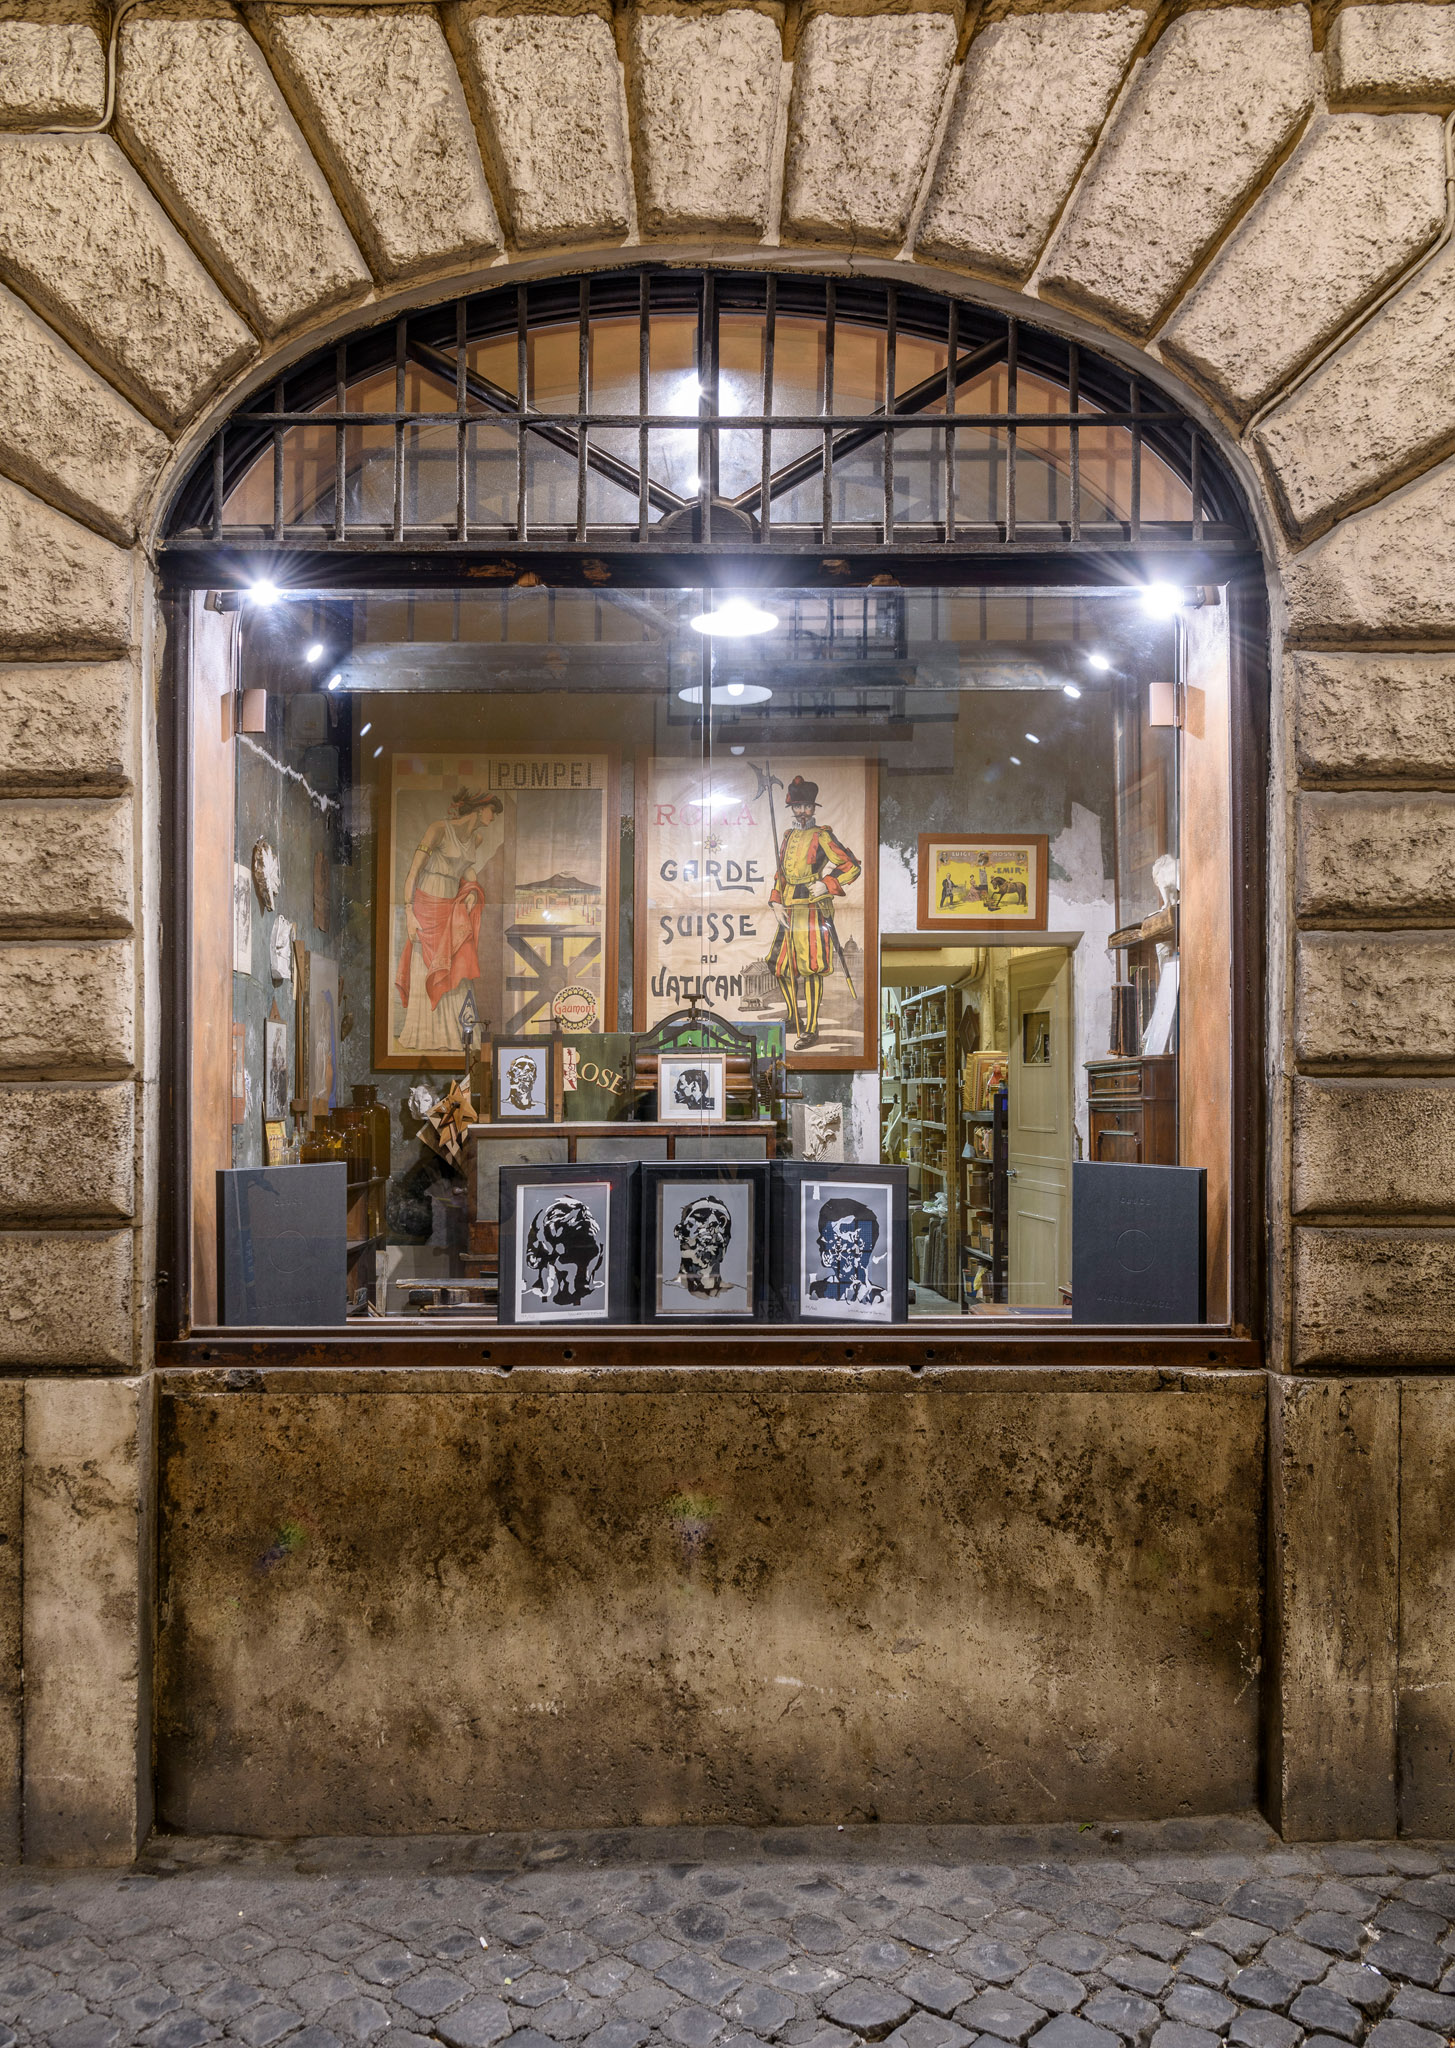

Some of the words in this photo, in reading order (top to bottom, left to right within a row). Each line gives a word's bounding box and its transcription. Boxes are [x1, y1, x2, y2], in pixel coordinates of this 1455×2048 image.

[497, 762, 592, 787] POMPEI
[660, 859, 765, 894] GARDE
[660, 912, 757, 945] SUISSE
[701, 954, 718, 964] AU
[651, 966, 743, 1007] VATICAN
[554, 1001, 595, 1017] Gaumont
